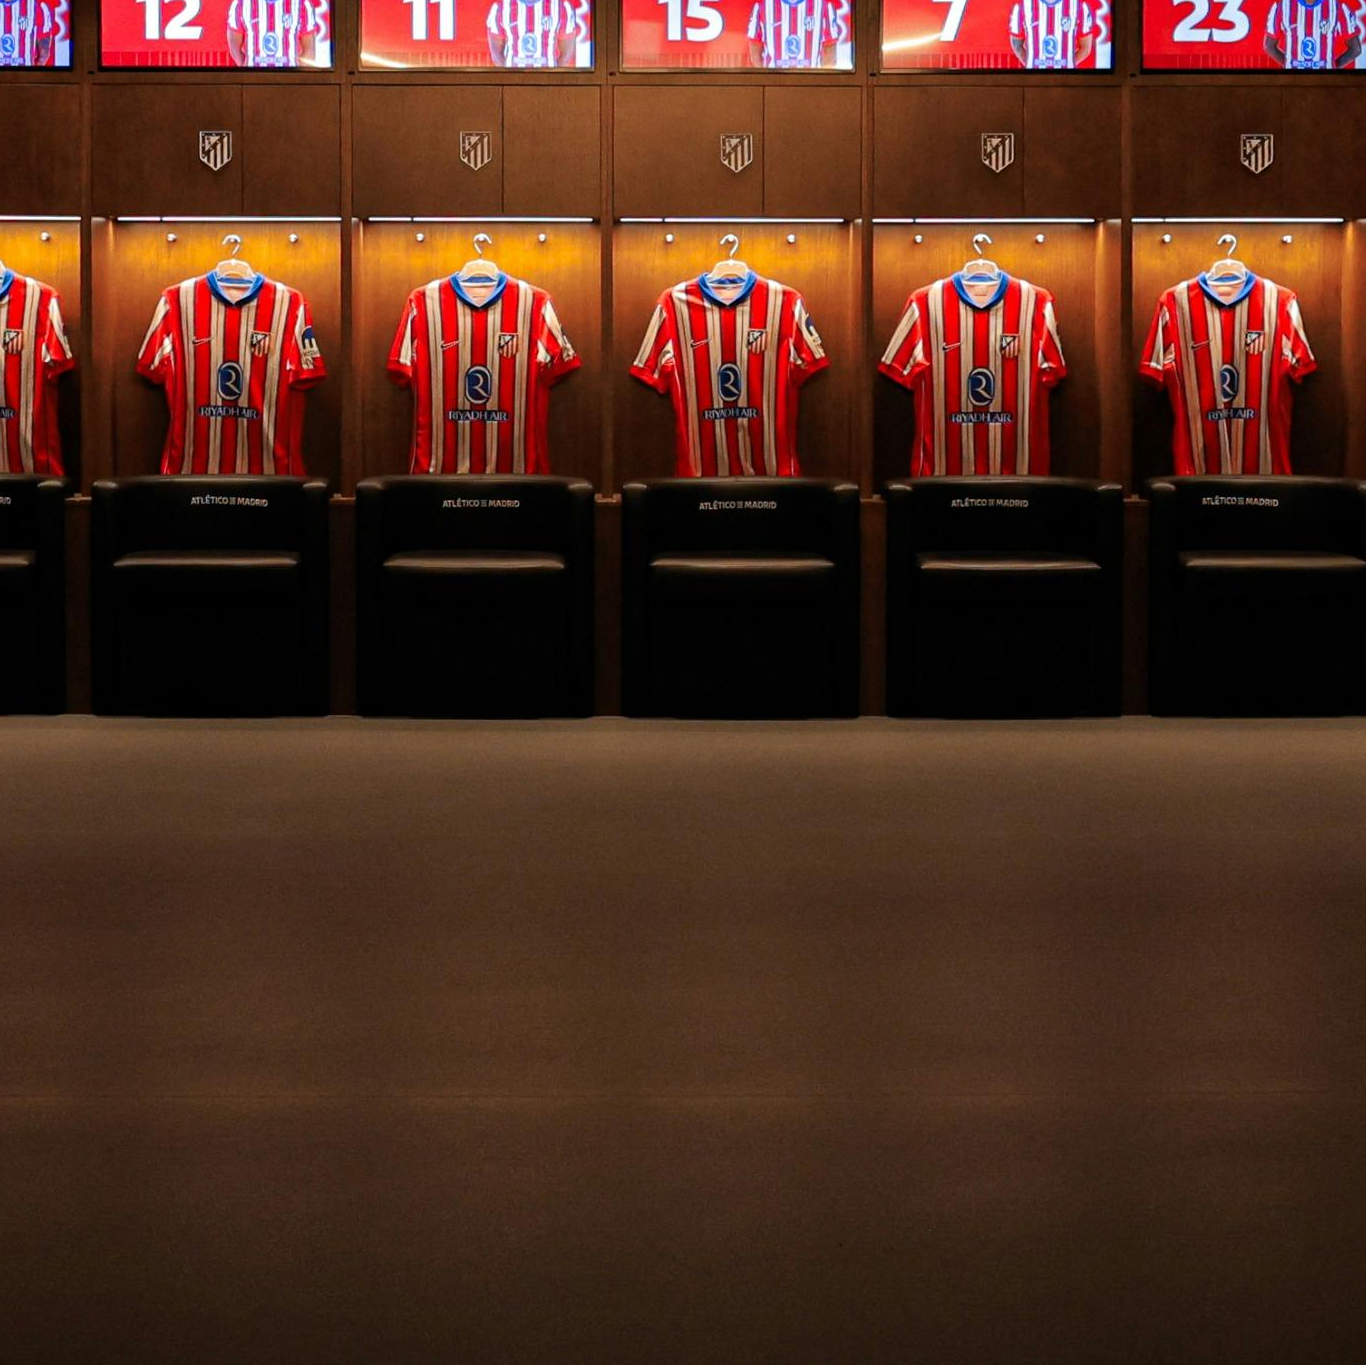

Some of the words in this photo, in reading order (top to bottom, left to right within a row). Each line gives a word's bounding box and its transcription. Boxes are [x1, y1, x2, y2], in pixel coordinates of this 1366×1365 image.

[0, 408, 15, 420] AIR
[242, 408, 258, 420] AIR
[488, 410, 508, 421] AIR
[739, 407, 757, 418] AIR
[992, 412, 1012, 423] AIR
[1236, 408, 1255, 420] AIR
[190, 494, 229, 505] ATLÉTICO
[236, 497, 269, 508] MADRID
[442, 497, 480, 508] ATLÉTICO
[488, 499, 520, 508] MADRID
[698, 499, 737, 510] ATLÉTICO
[744, 500, 777, 510] MADRID
[951, 497, 988, 508] ATLÉTICO
[995, 498, 1029, 508] MADRID
[1201, 495, 1238, 506] ATLÉTICO
[1245, 497, 1279, 507] MADRID
